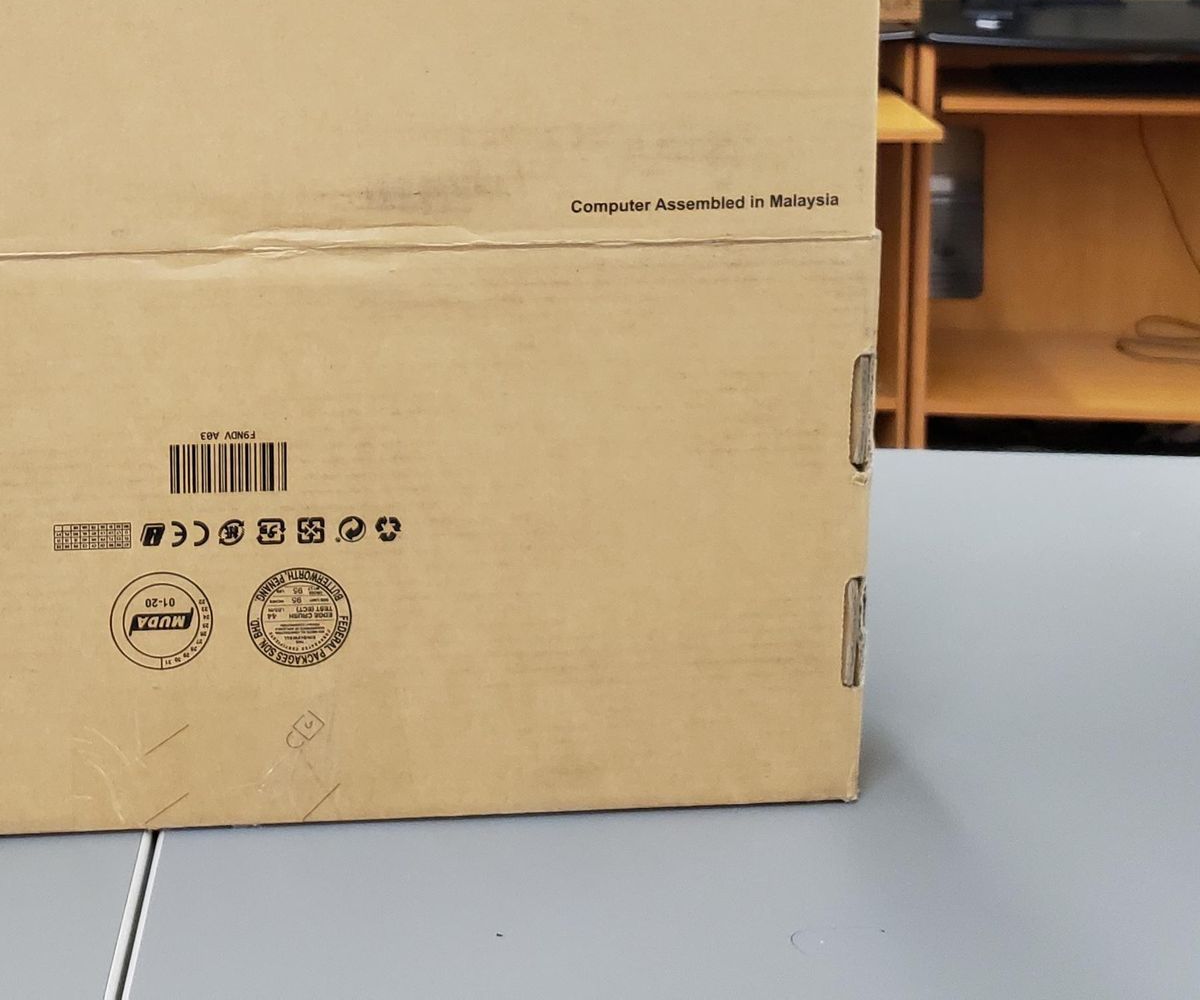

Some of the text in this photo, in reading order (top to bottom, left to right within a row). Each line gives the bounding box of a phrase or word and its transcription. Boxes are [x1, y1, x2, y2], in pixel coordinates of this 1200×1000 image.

[571, 193, 839, 215] Computer Assembled in Malaysia
[200, 430, 256, 440] F9NDV A03
[145, 598, 175, 607] 01-20
[137, 616, 185, 628] MUDA
[324, 616, 348, 652] FEDERAL
[276, 649, 326, 664] PACKAGES
